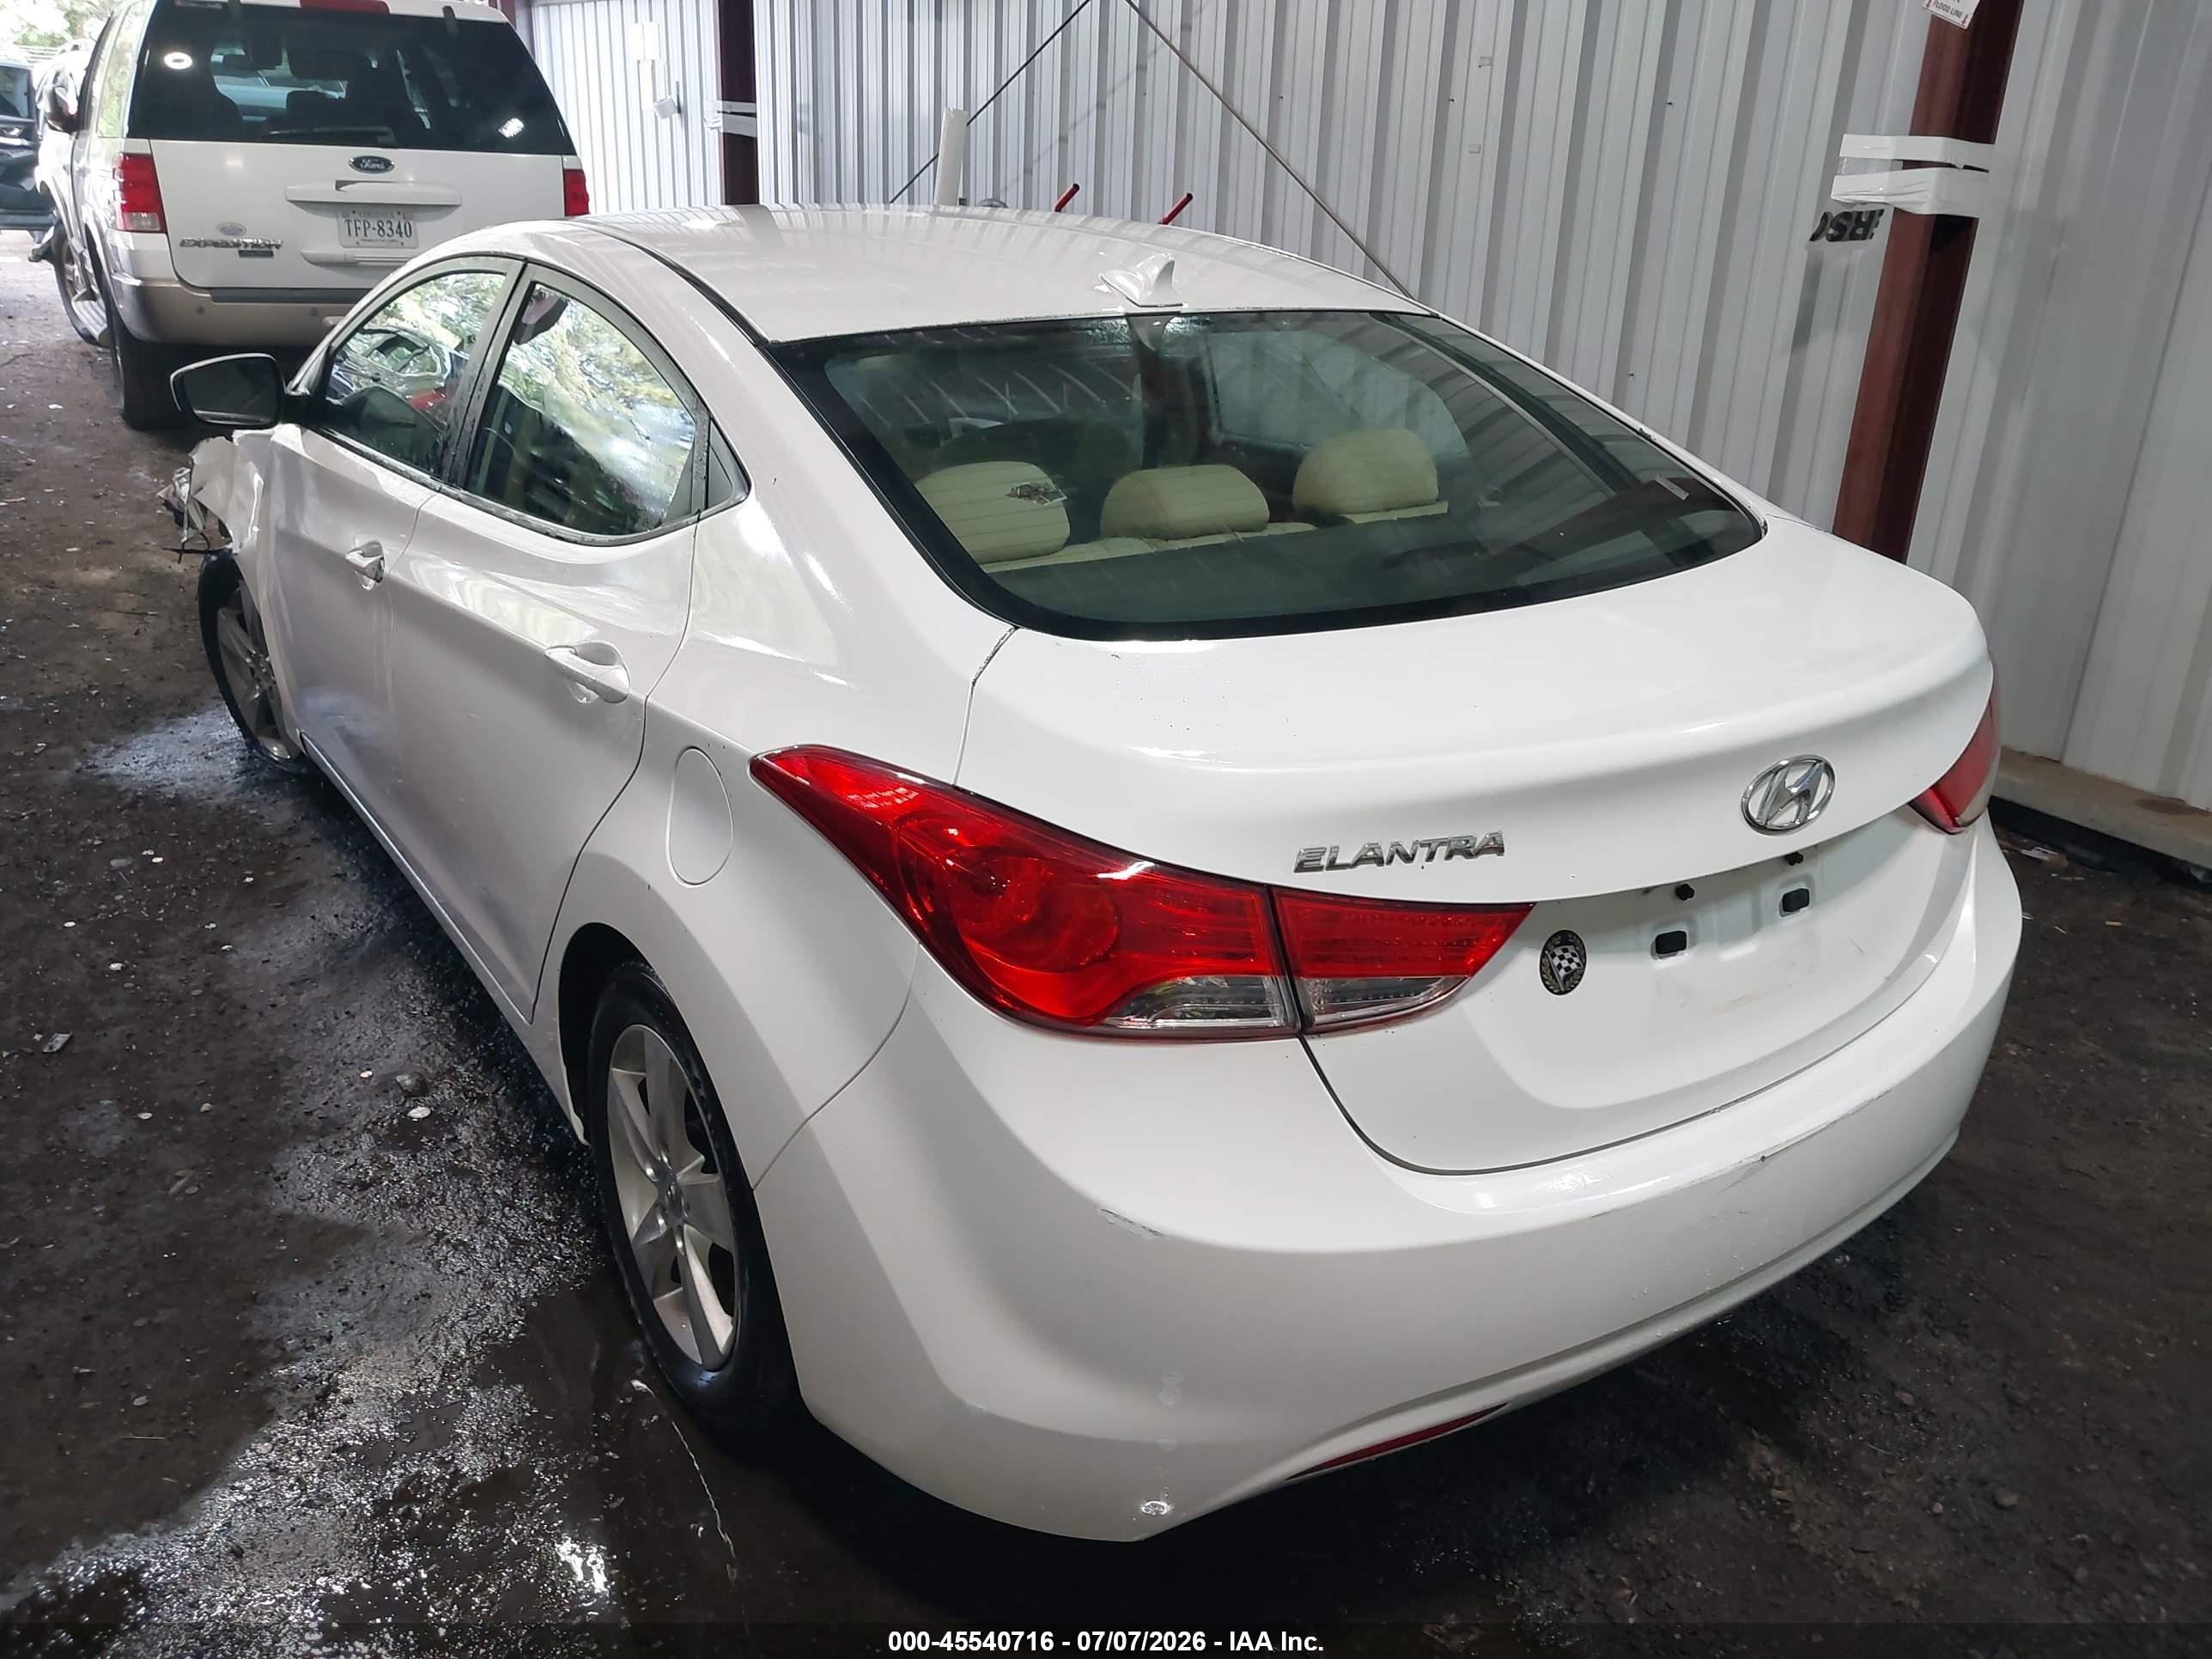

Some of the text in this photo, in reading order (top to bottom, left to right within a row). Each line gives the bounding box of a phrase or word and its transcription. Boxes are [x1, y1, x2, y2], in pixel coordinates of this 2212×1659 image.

[1950, 8, 1964, 18] LINE
[344, 218, 412, 239] TFP-8340
[1293, 830, 1505, 873] ELANTRA
